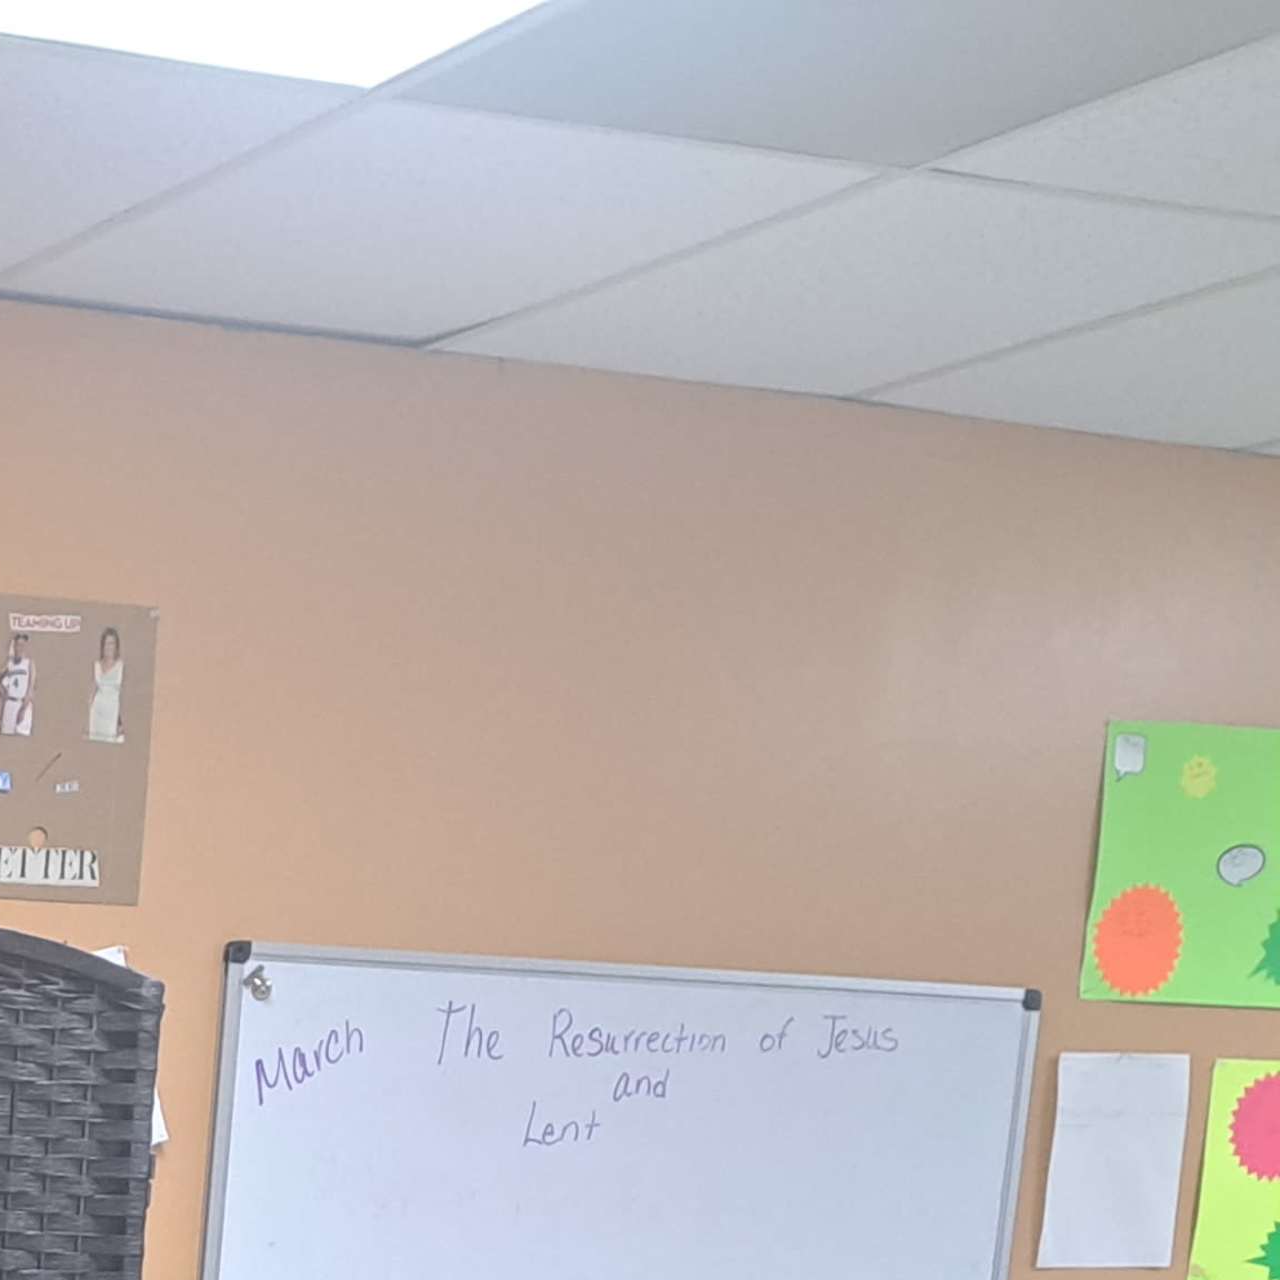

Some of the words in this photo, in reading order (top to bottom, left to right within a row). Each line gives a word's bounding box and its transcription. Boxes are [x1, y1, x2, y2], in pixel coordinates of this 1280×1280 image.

[12, 616, 63, 629] TEAMING
[436, 999, 505, 1066] The
[548, 1009, 727, 1059] Resurrection
[758, 1016, 794, 1055] of
[817, 1013, 901, 1057] Jesus
[254, 1019, 366, 1106] March
[612, 1067, 671, 1103] and
[521, 1099, 603, 1148] Lent
